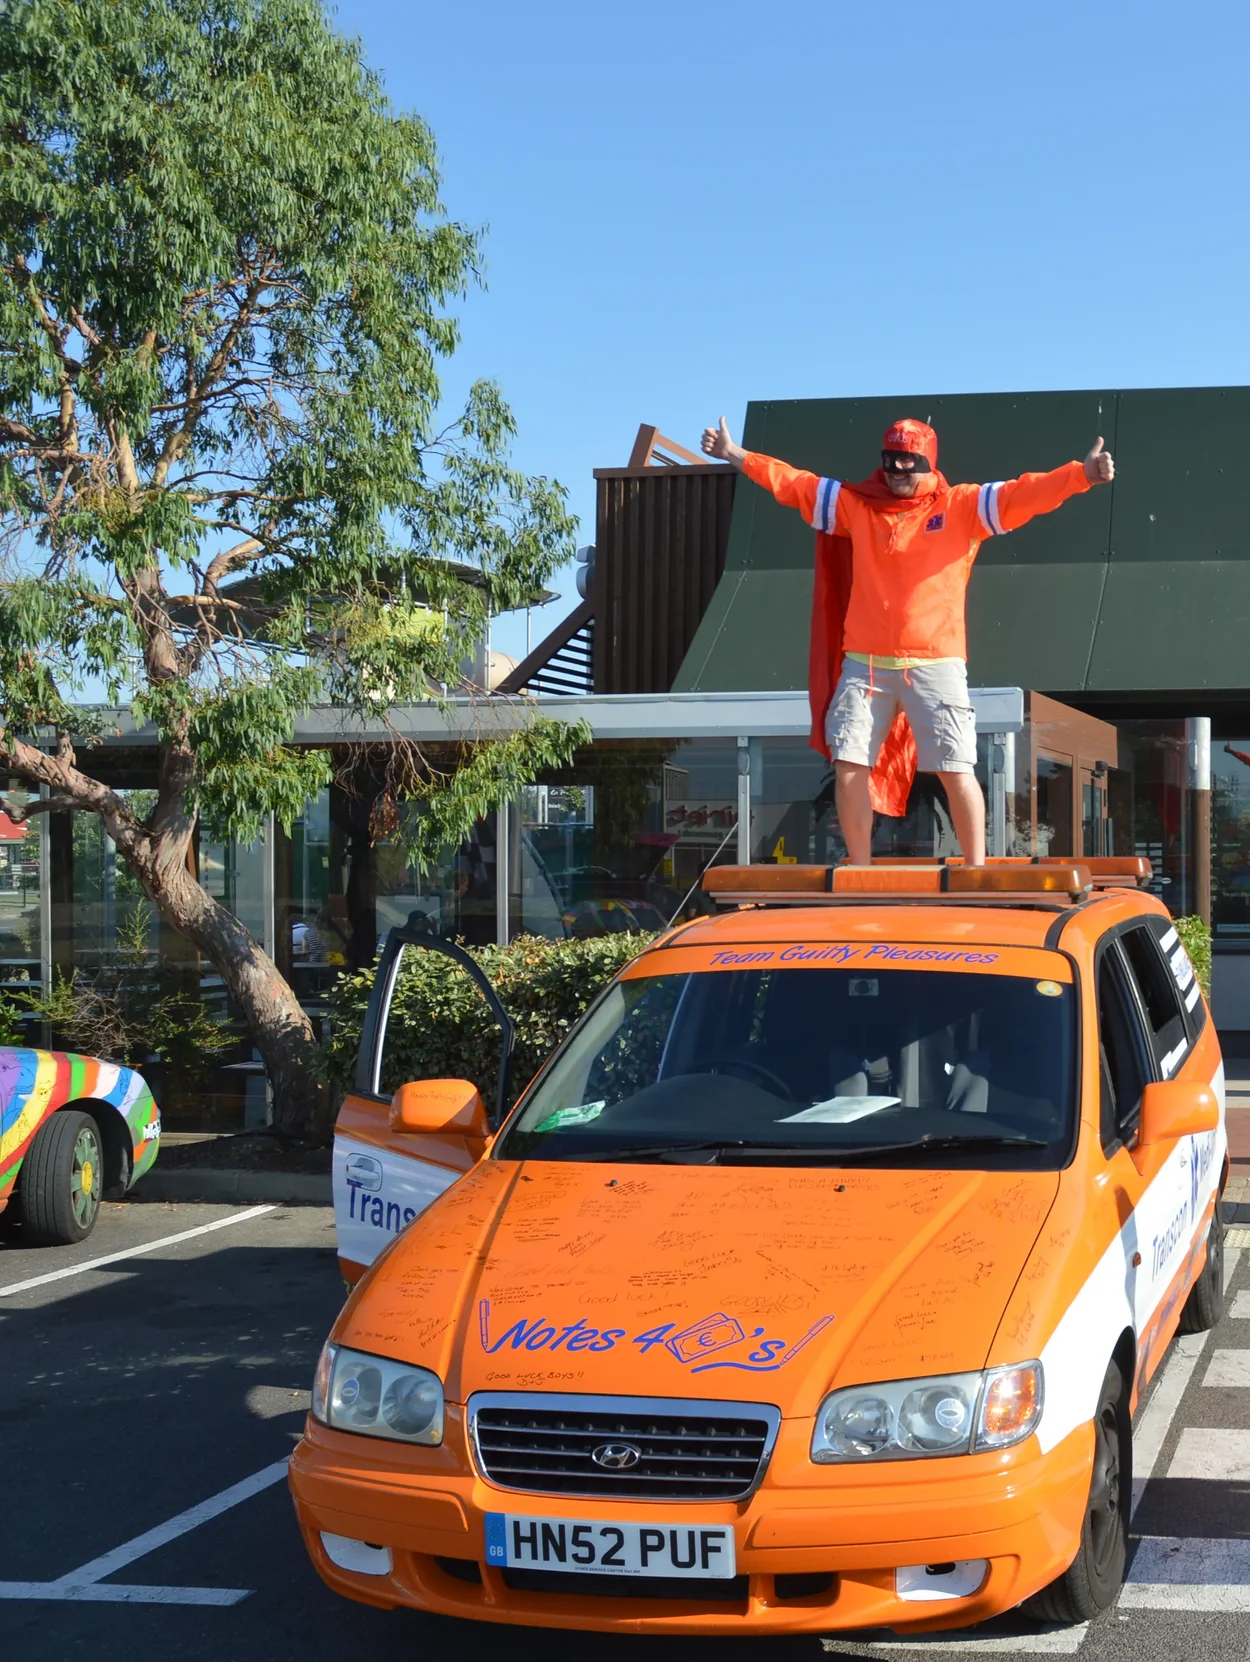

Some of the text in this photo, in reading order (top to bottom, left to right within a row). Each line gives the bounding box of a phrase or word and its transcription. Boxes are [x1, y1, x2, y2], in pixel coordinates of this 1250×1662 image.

[710, 944, 999, 965] Team Guilty Pleasures
[487, 1318, 626, 1353] Notes
[632, 1323, 676, 1354] 4
[485, 1371, 511, 1381] GOOD
[516, 1372, 545, 1380] LUCK
[489, 1544, 504, 1557] GB
[512, 1520, 726, 1569] HN52 PUF
